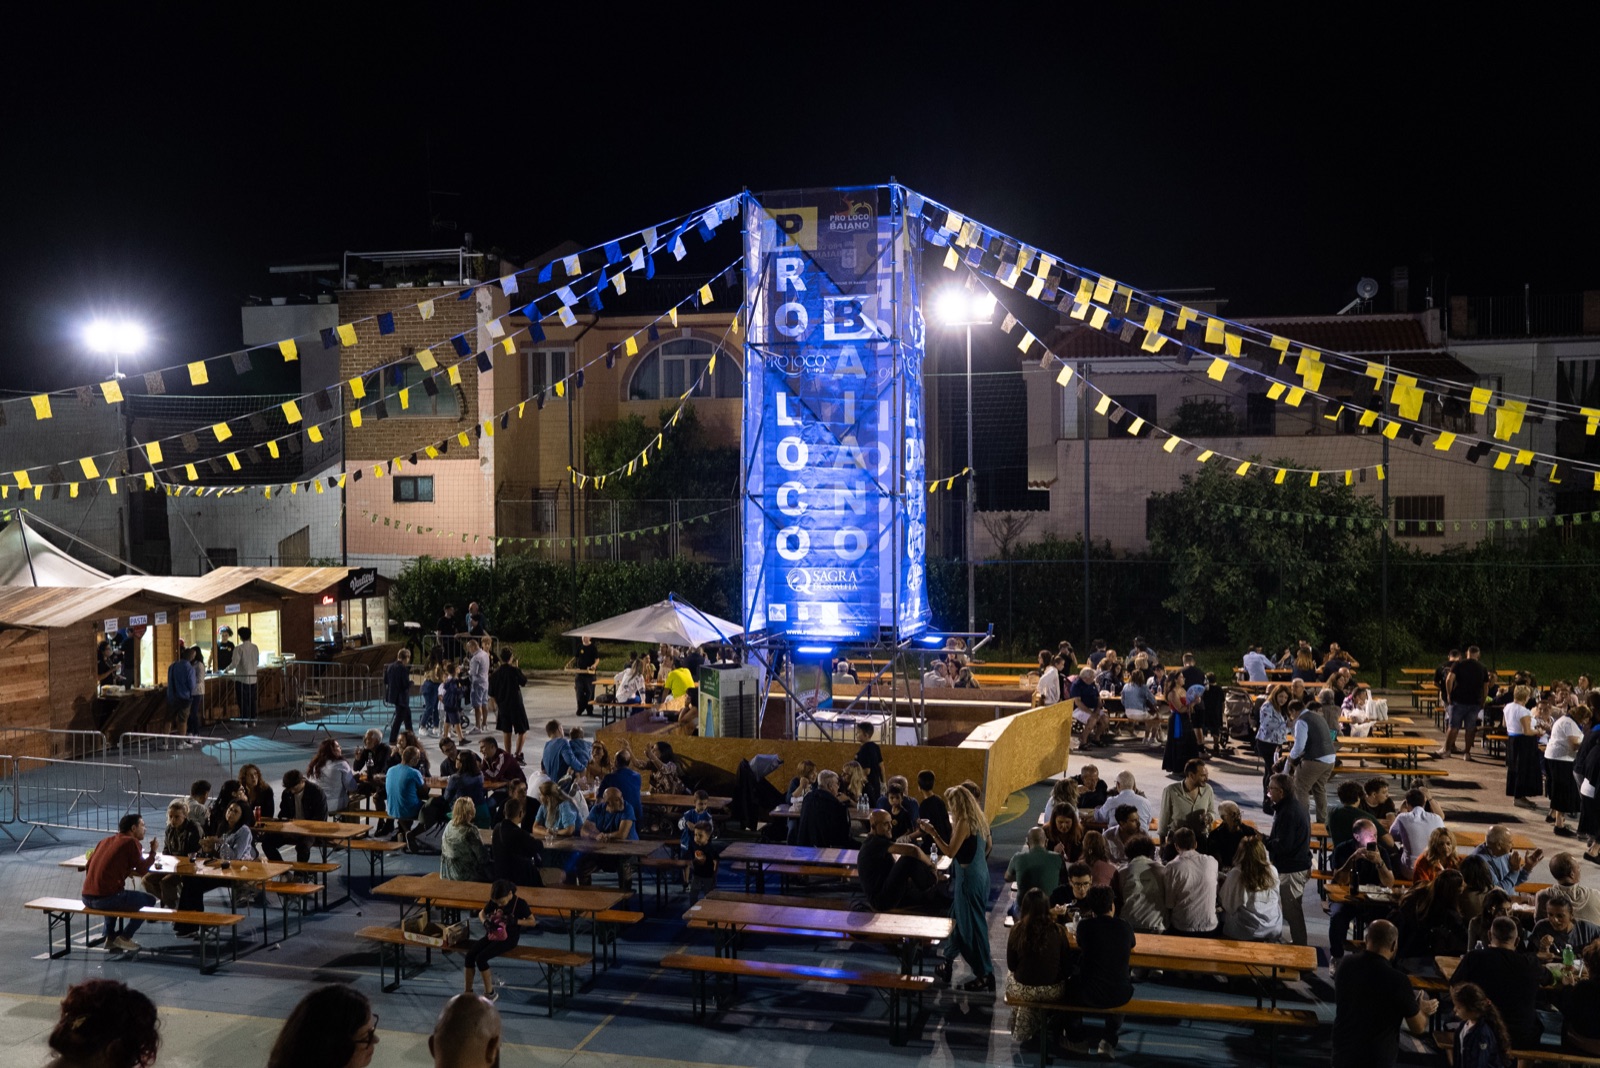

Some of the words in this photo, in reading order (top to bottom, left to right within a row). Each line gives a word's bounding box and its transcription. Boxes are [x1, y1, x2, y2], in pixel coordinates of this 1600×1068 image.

[829, 214, 846, 222] PRO
[848, 213, 870, 222] LOCO
[829, 221, 870, 231] BAIANO
[764, 354, 789, 369] PRO
[790, 354, 827, 372] LOCO
[776, 391, 811, 562] LOCO
[813, 569, 857, 582] SAGRA
[130, 616, 147, 626] PASTA
